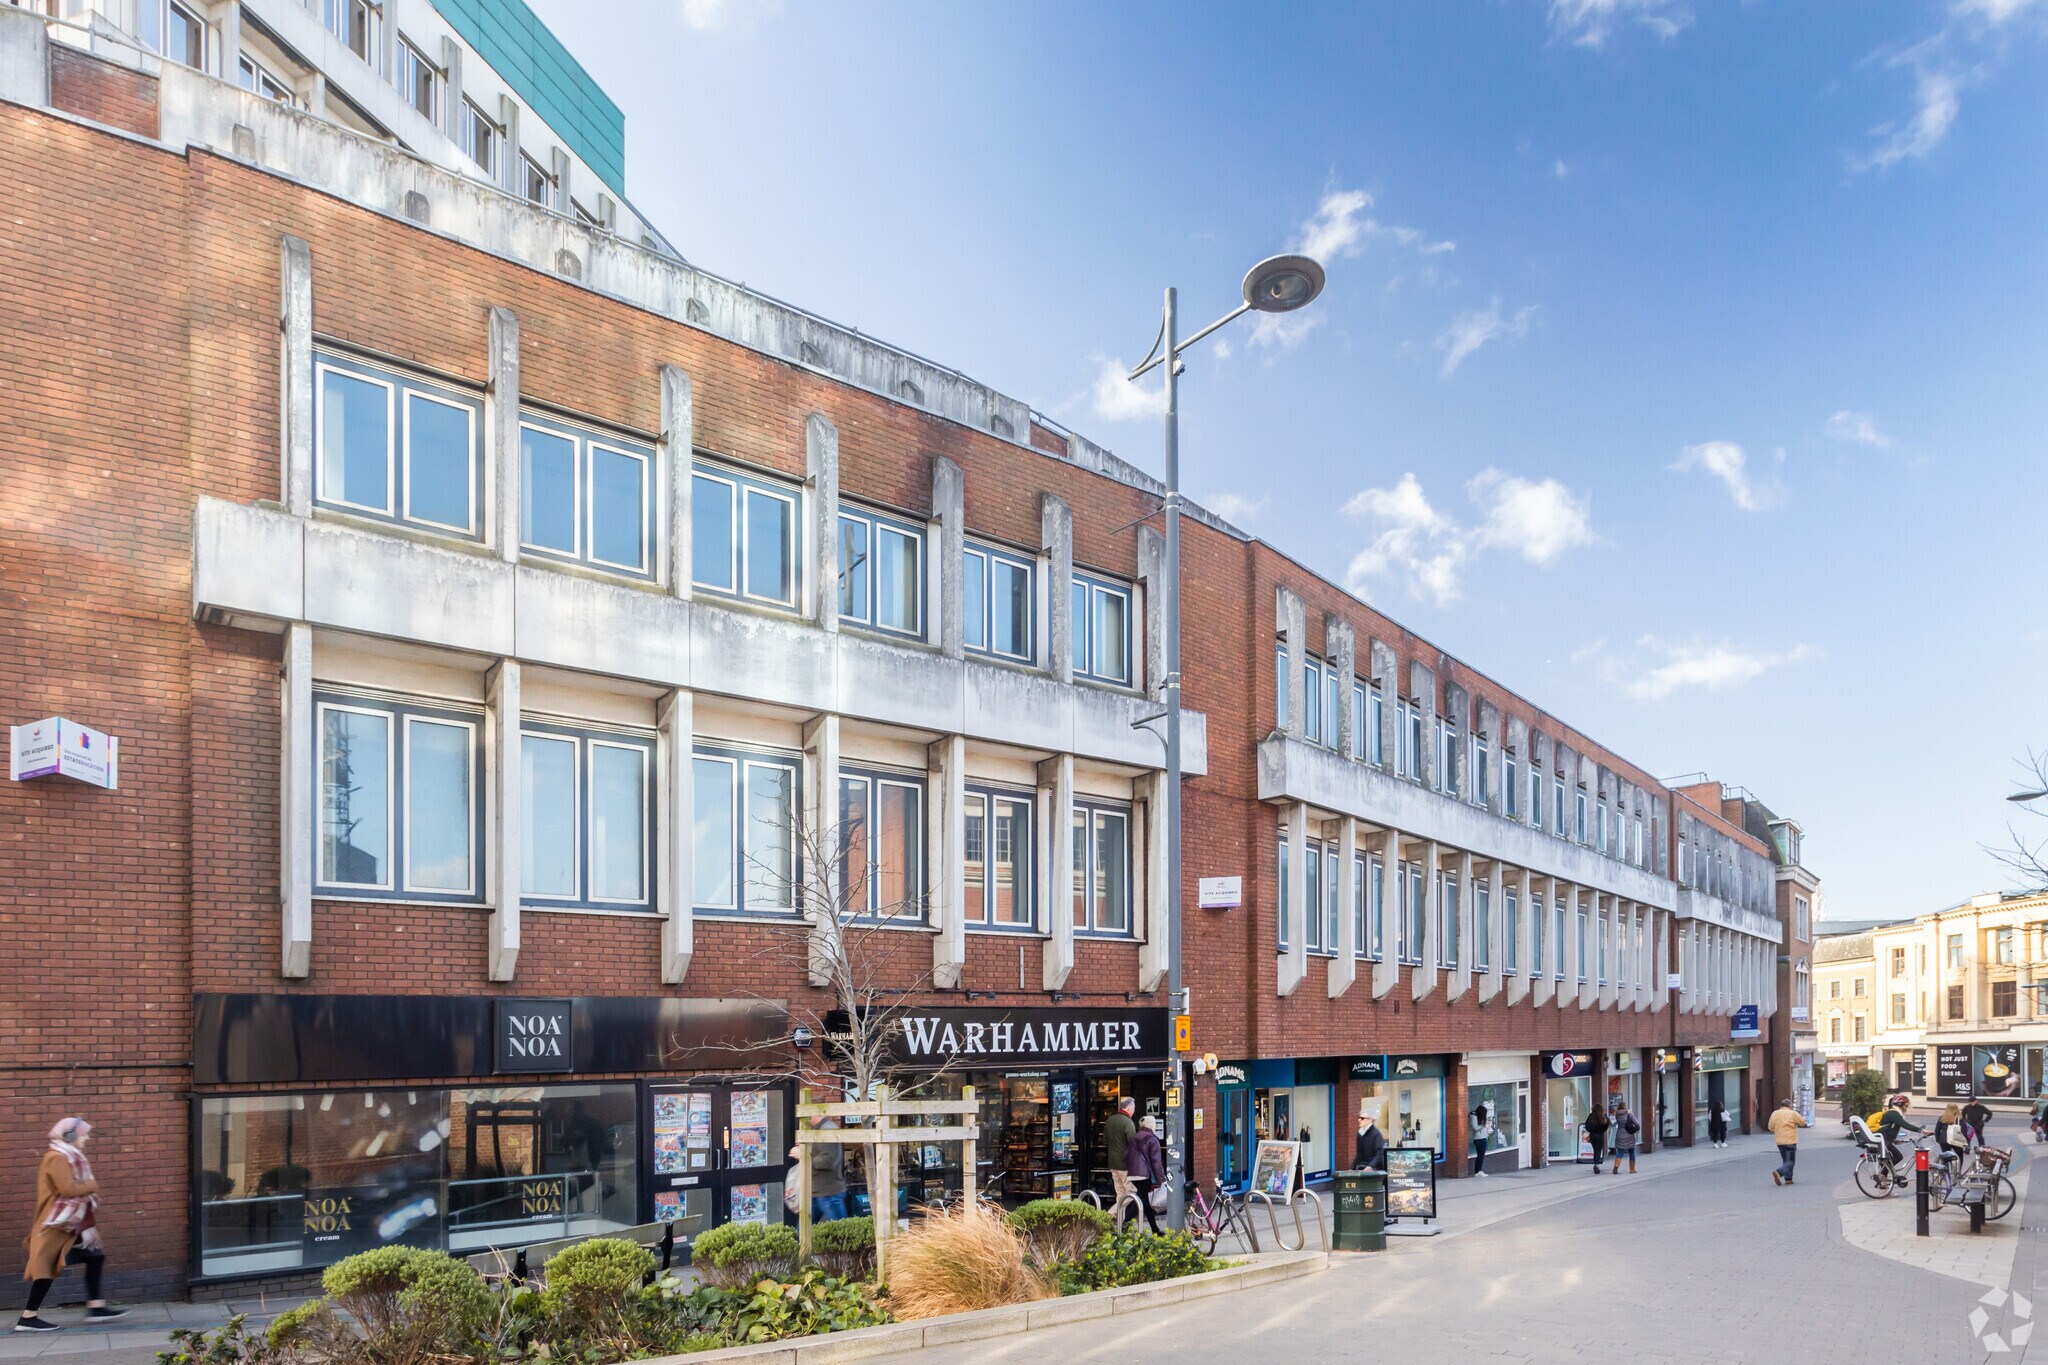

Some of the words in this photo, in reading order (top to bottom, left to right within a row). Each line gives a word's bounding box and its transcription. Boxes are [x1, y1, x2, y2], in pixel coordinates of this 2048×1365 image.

[32, 744, 54, 754] ACQUIRED
[508, 1015, 562, 1036] NOA
[902, 1017, 1142, 1055] WARHAMMER
[508, 1036, 562, 1057] NOA
[1005, 1071, 1049, 1079] games-workshop.com
[1215, 1065, 1246, 1082] ADNAMS
[1351, 1062, 1381, 1072] ADNAMS
[1955, 1083, 1971, 1091] M&S
[521, 1181, 562, 1199] NOA
[303, 1198, 353, 1217] NOA
[521, 1197, 561, 1214] NOA
[303, 1215, 352, 1234] NOA
